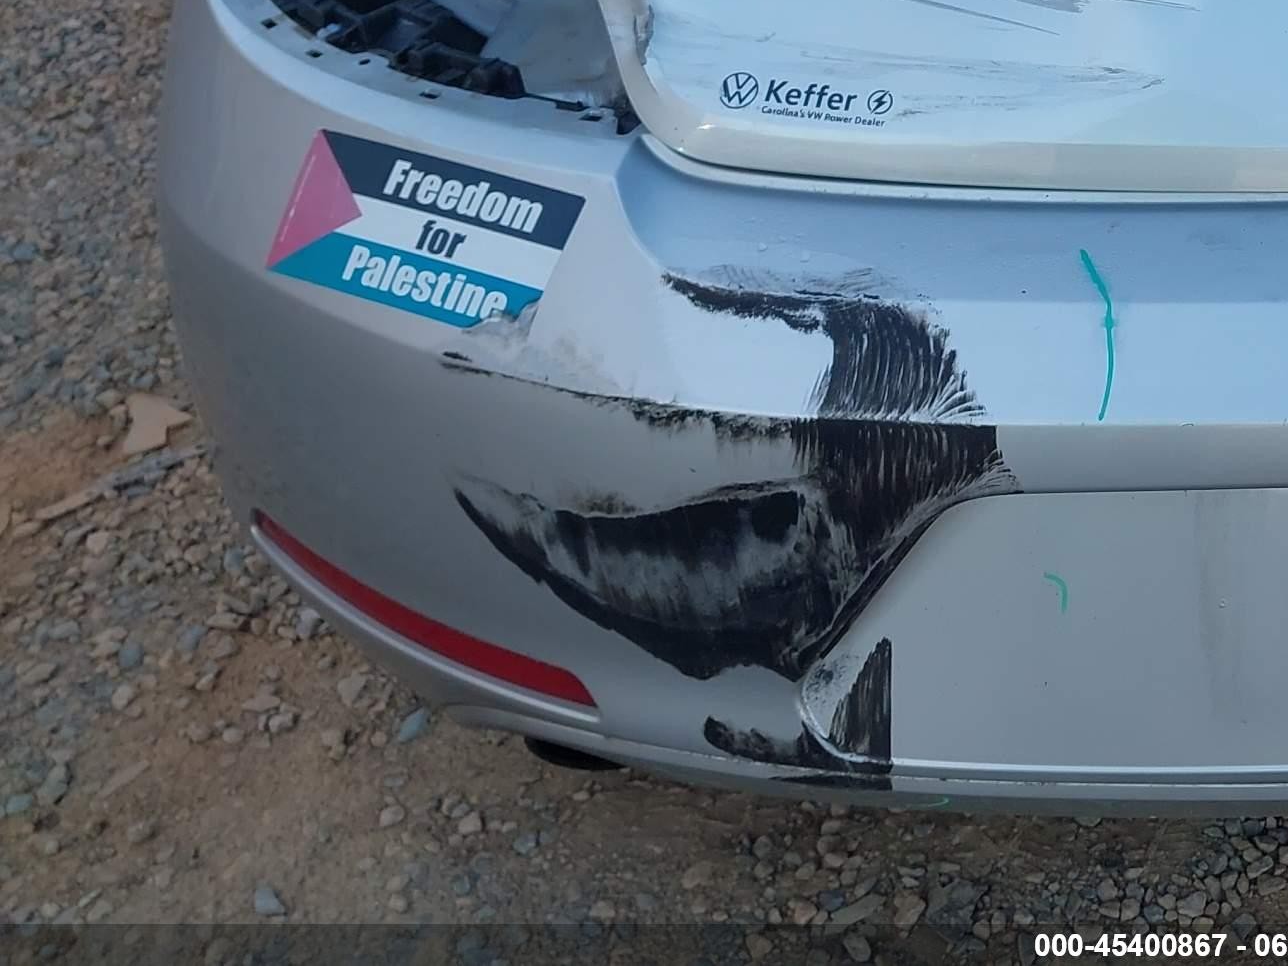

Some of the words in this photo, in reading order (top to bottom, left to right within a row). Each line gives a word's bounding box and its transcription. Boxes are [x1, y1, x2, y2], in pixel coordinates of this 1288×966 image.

[764, 79, 858, 112] Keffer
[761, 105, 805, 119] Carolina's
[807, 110, 824, 121] VW
[824, 112, 853, 124] Power
[855, 115, 886, 128] Dealer
[382, 159, 544, 234] Freedom
[415, 220, 467, 259] for
[342, 244, 508, 320] Palestine
